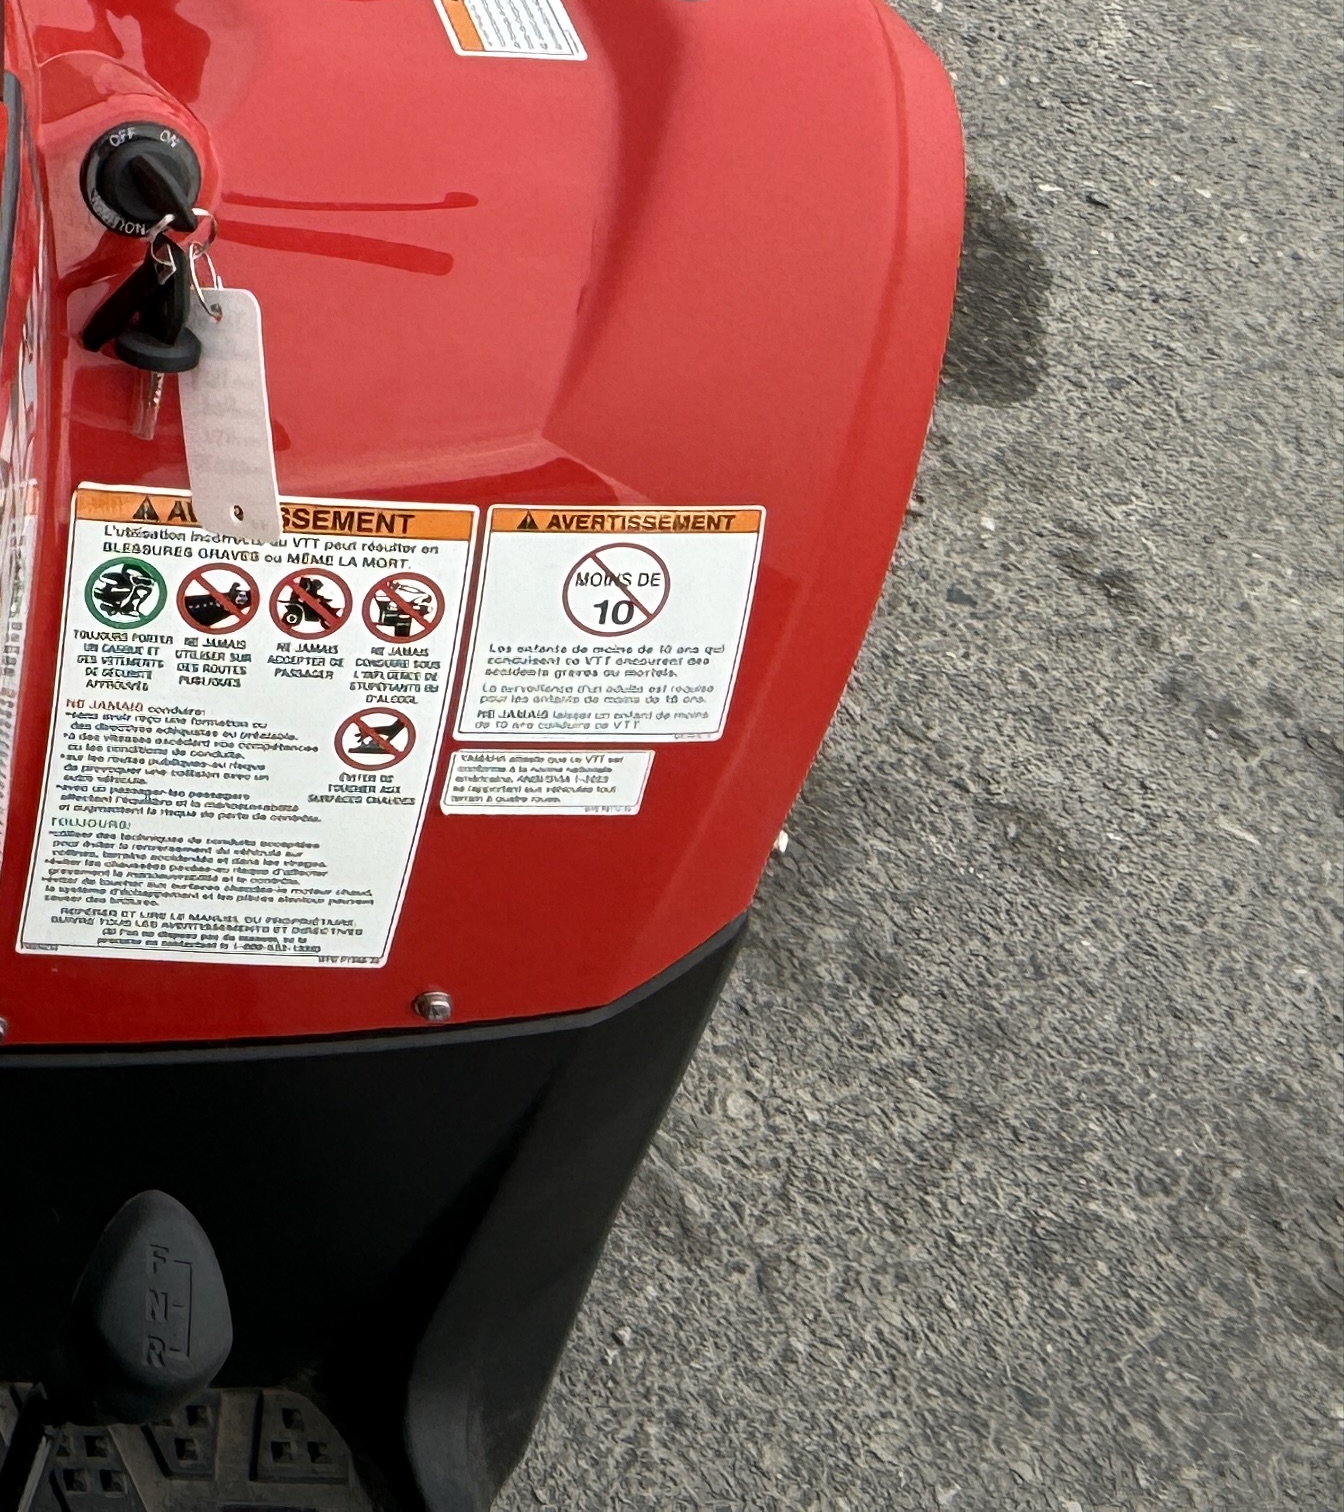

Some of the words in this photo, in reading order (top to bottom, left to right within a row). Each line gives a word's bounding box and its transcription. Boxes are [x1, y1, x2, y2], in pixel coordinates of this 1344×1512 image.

[109, 127, 137, 147] OFF
[160, 129, 181, 148] ON
[545, 513, 737, 532] AVERTISSEMENT
[292, 537, 321, 550] VTT
[264, 554, 283, 564] ou
[338, 556, 358, 568] LA
[637, 572, 661, 588] DE
[593, 598, 635, 626] 10
[145, 1287, 169, 1322] N
[141, 1333, 167, 1368] R
